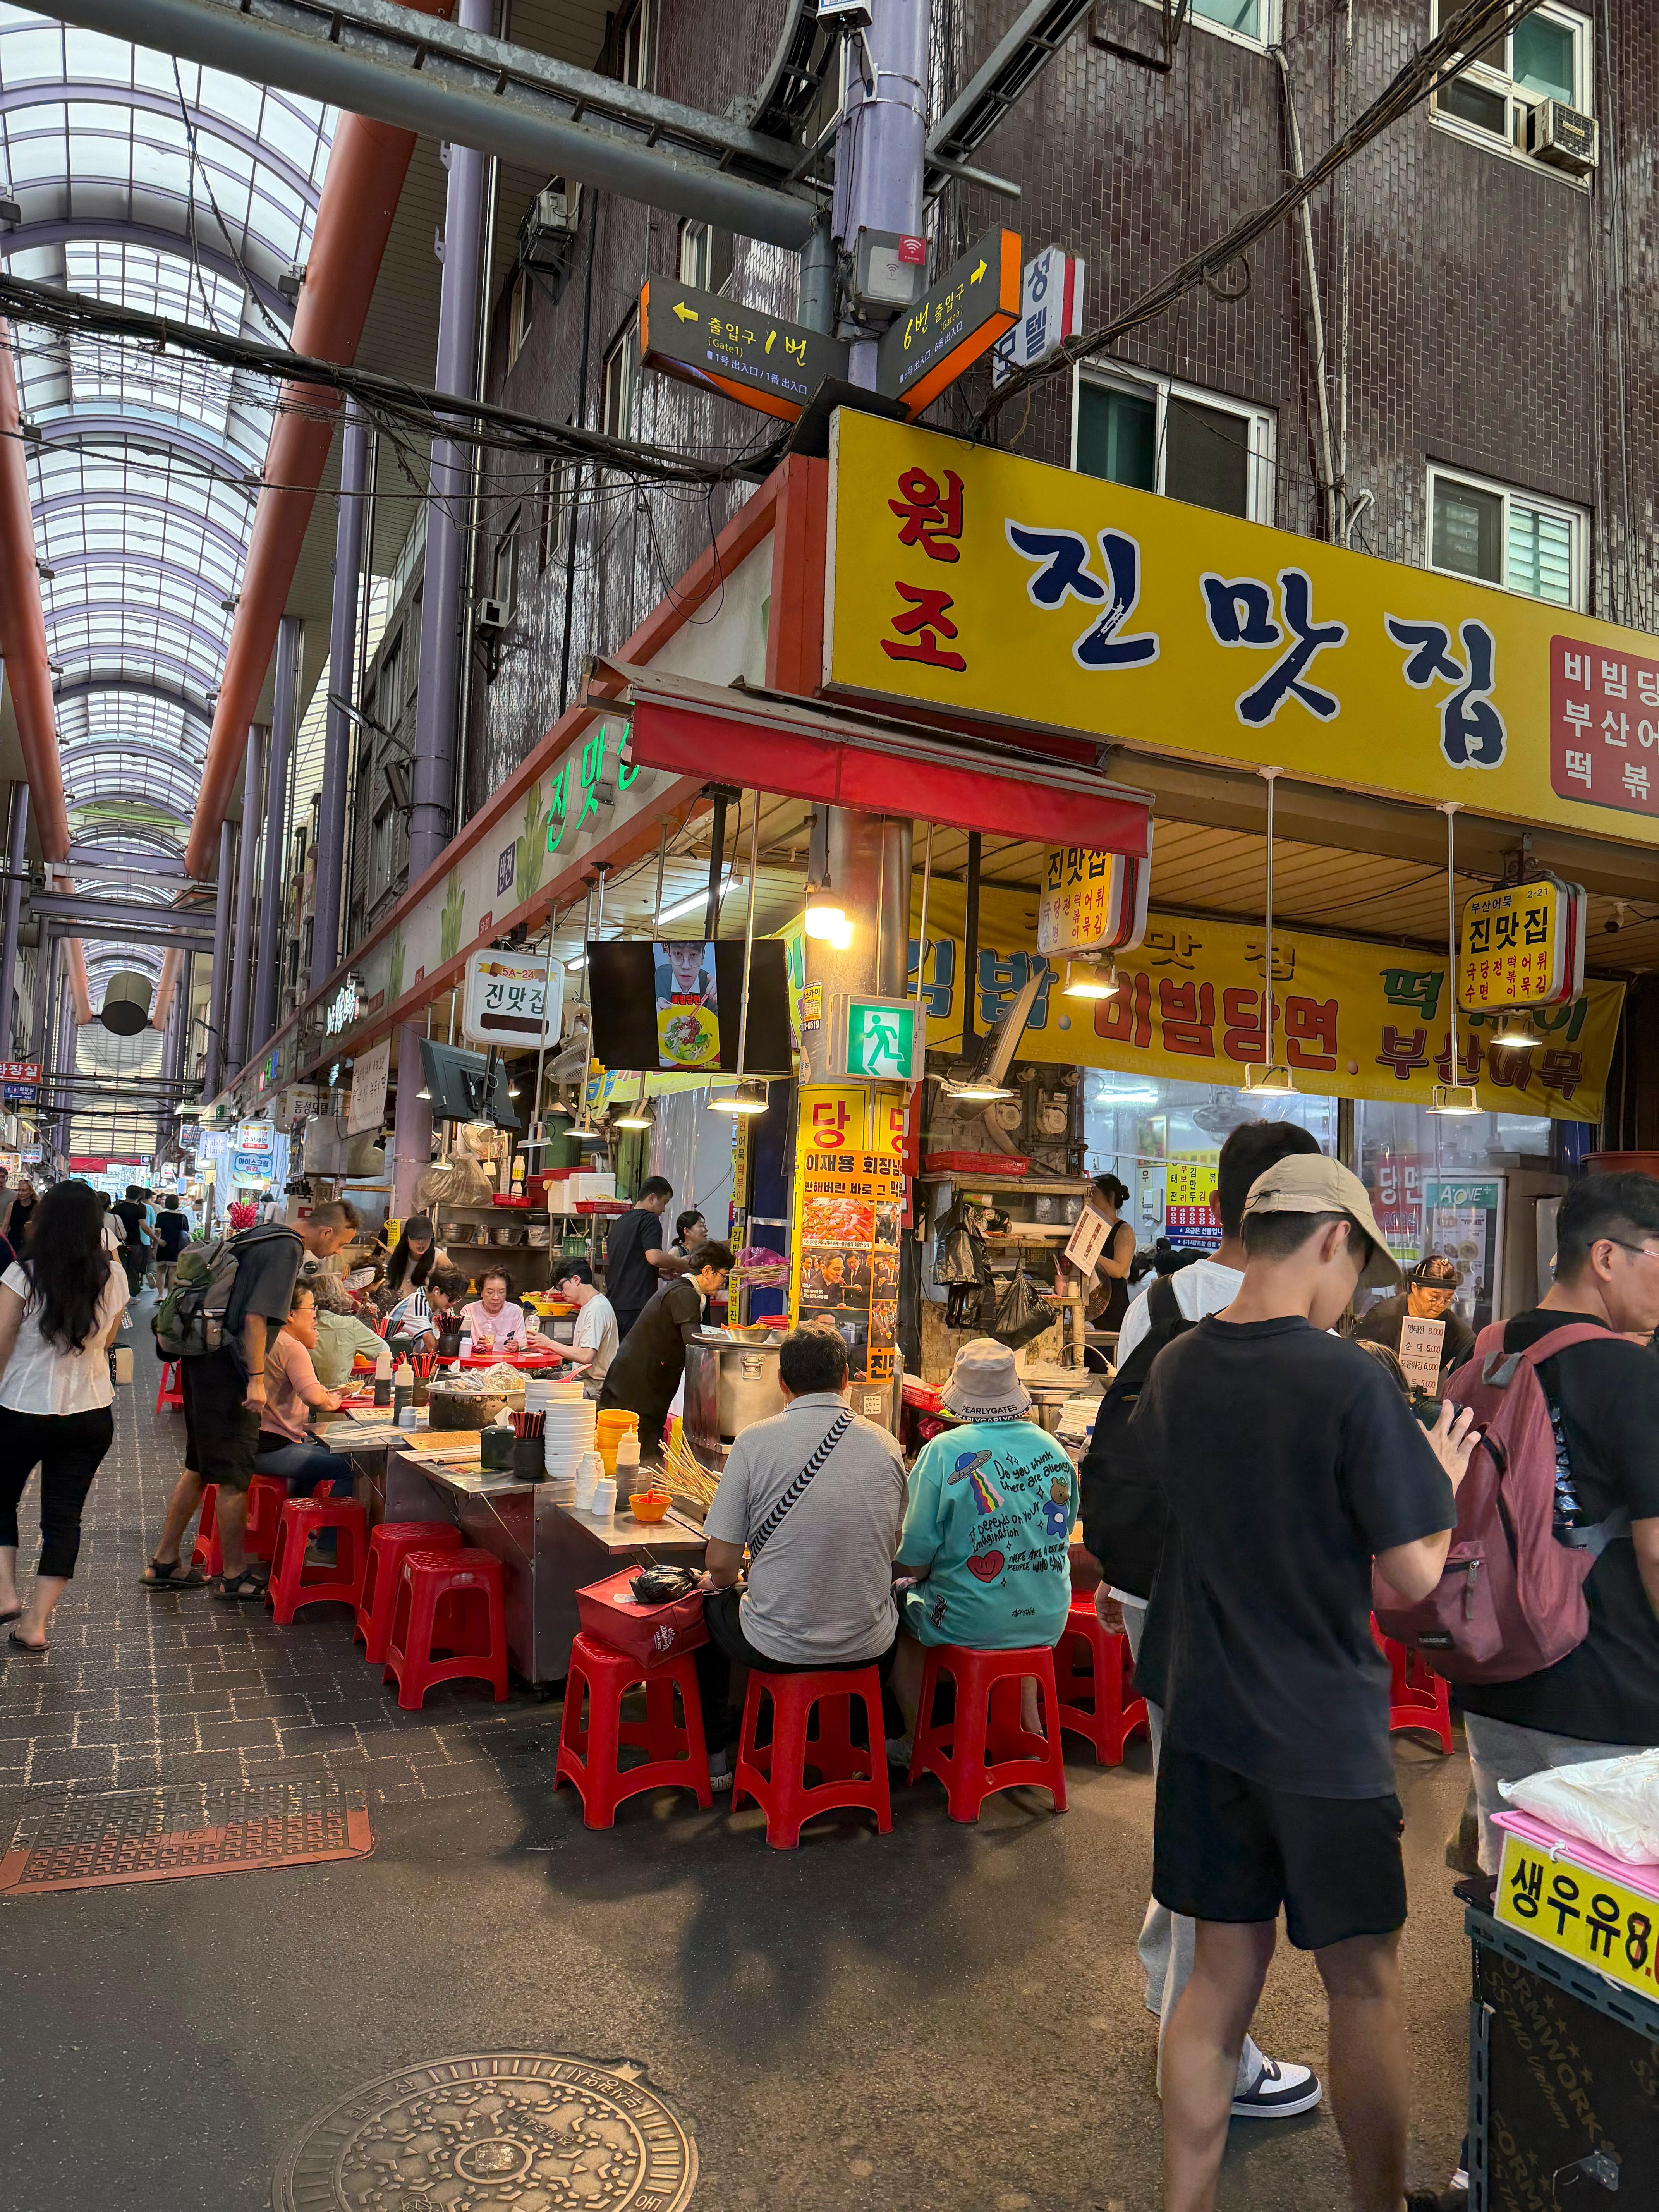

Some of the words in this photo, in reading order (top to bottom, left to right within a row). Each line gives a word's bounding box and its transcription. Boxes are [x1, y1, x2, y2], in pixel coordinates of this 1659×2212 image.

[934, 283, 965, 324] 출입구
[708, 317, 756, 344] 출입구
[708, 336, 743, 357] (Gate1)
[880, 466, 967, 673] 원조
[1005, 518, 1509, 771] 진맛집
[1471, 895, 1512, 915] 부산어묵
[1527, 886, 1549, 899] 2-21
[1468, 906, 1548, 955] 진맛집
[501, 967, 535, 980] 5A-24
[1506, 955, 1517, 998] 떡볶이
[1520, 953, 1532, 995] 어묵
[1535, 950, 1547, 994] 튀김
[484, 983, 546, 1015] 진맛집
[1375, 1024, 1583, 1100] 부산어묵
[813, 1099, 850, 1149] 당
[238, 1157, 269, 1167] 아이스크림
[738, 1135, 745, 1161] 어묵
[805, 1154, 854, 1173] 이재용
[805, 1181, 845, 1194] 반해버린
[850, 1183, 872, 1195] 바로
[876, 1184, 886, 1196] 그
[962, 1403, 1017, 1415] PEARLYGATES
[993, 1460, 1011, 1480] Do
[1012, 1464, 1030, 1480] you
[1032, 1451, 1053, 1471] think
[1000, 1480, 1025, 1493] there
[1027, 1473, 1042, 1487] are
[969, 1526, 976, 1542] It
[1007, 1561, 1030, 1572] PEOPLE
[1032, 1558, 1048, 1573] WHO
[1009, 1550, 1027, 1564] THERE
[1028, 1547, 1042, 1561] ARE
[1044, 1545, 1048, 1556] A
[1048, 1544, 1058, 1553] LOT
[1510, 1857, 1621, 1958] 생우유
[1503, 2009, 1533, 2051] TMD
[1527, 2055, 1570, 2129] Vietnam
